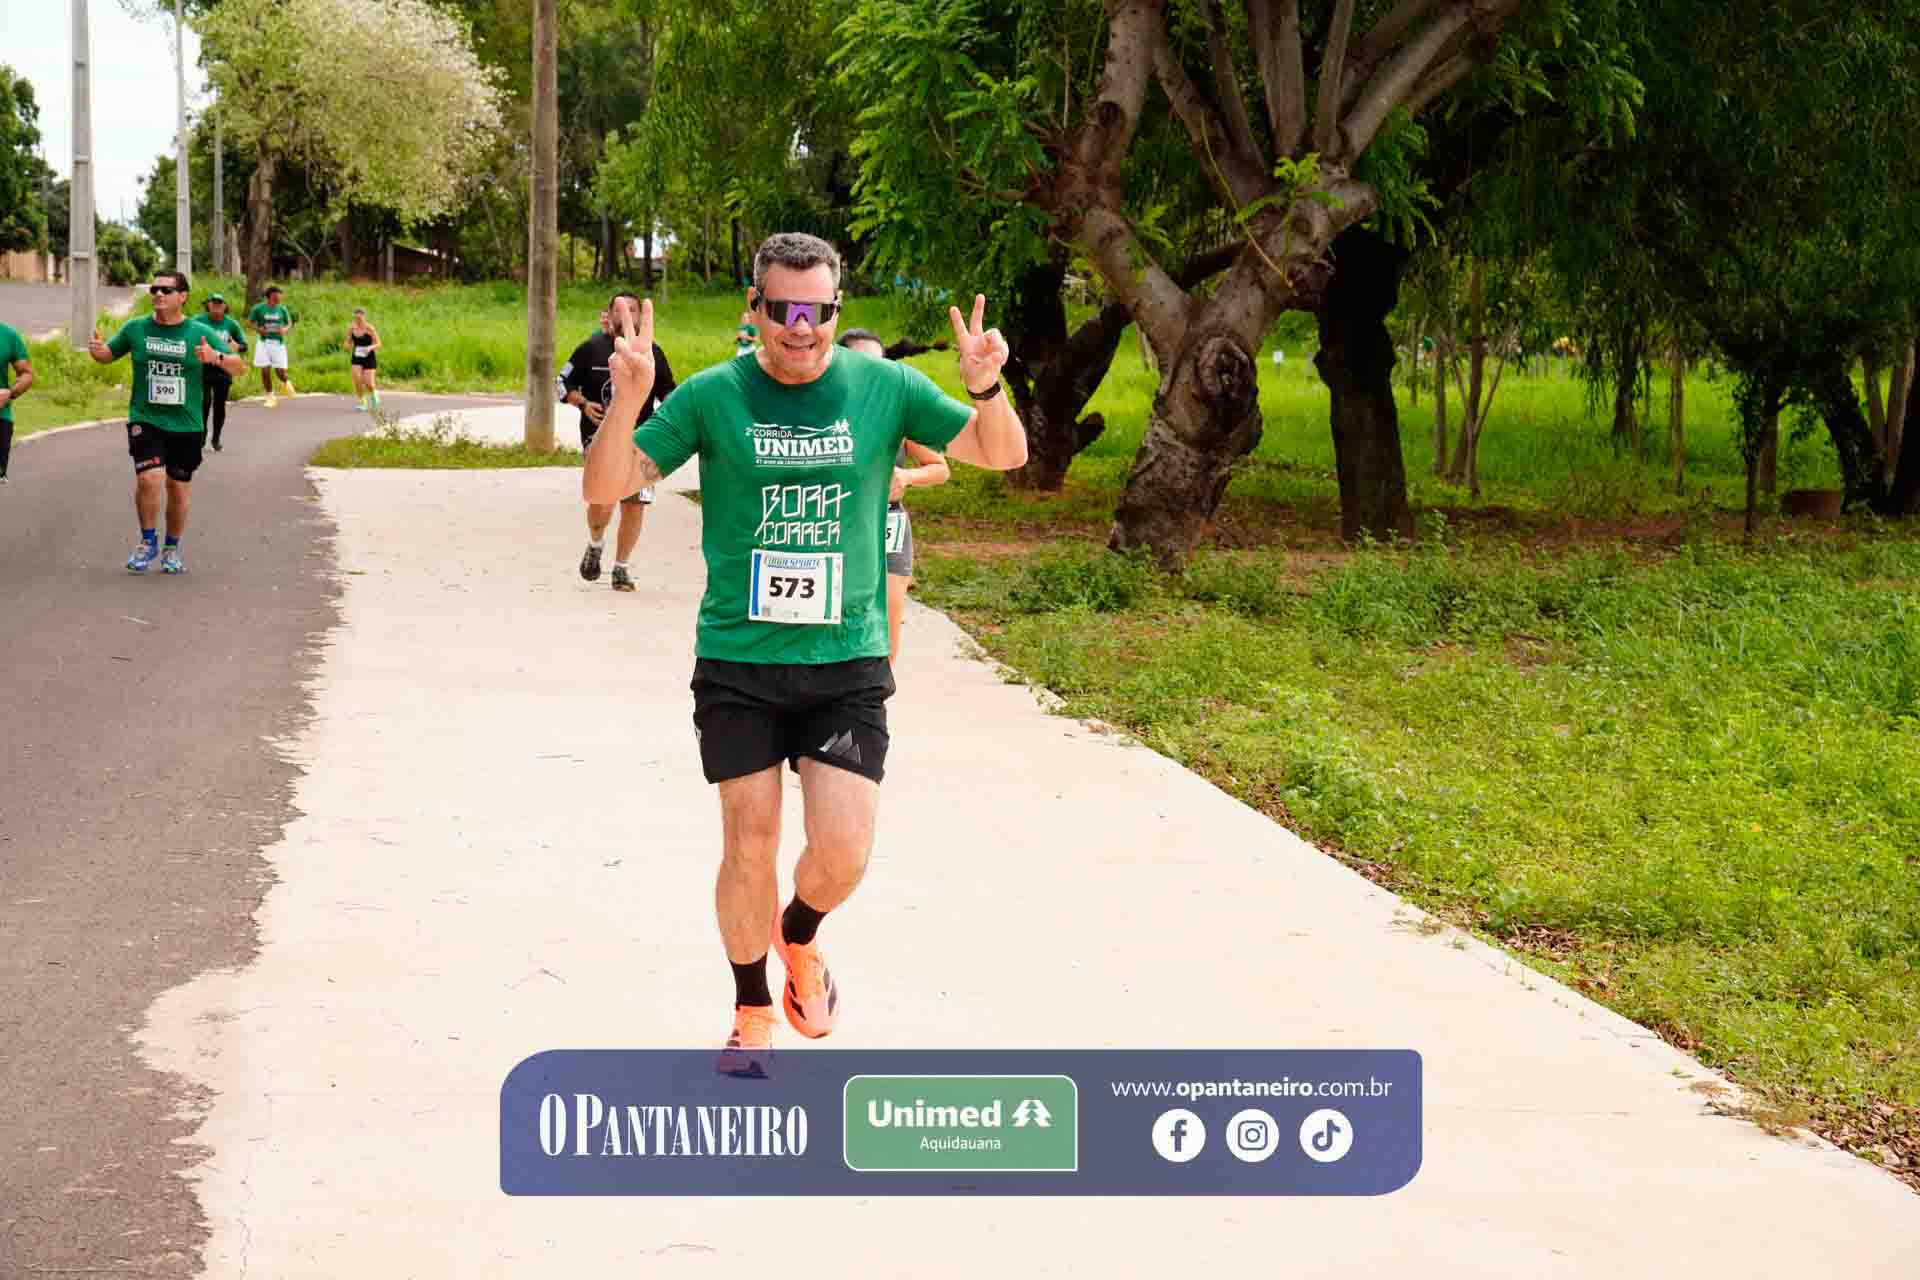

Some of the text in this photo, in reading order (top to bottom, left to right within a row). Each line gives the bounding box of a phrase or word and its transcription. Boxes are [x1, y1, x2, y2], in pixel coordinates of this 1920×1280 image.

[156, 386, 175, 395] 590
[753, 429, 793, 439] CORRIDA
[753, 435, 854, 457] UNIMED
[755, 484, 852, 537] BORA
[762, 520, 841, 545] CORRER
[769, 576, 815, 599] 573
